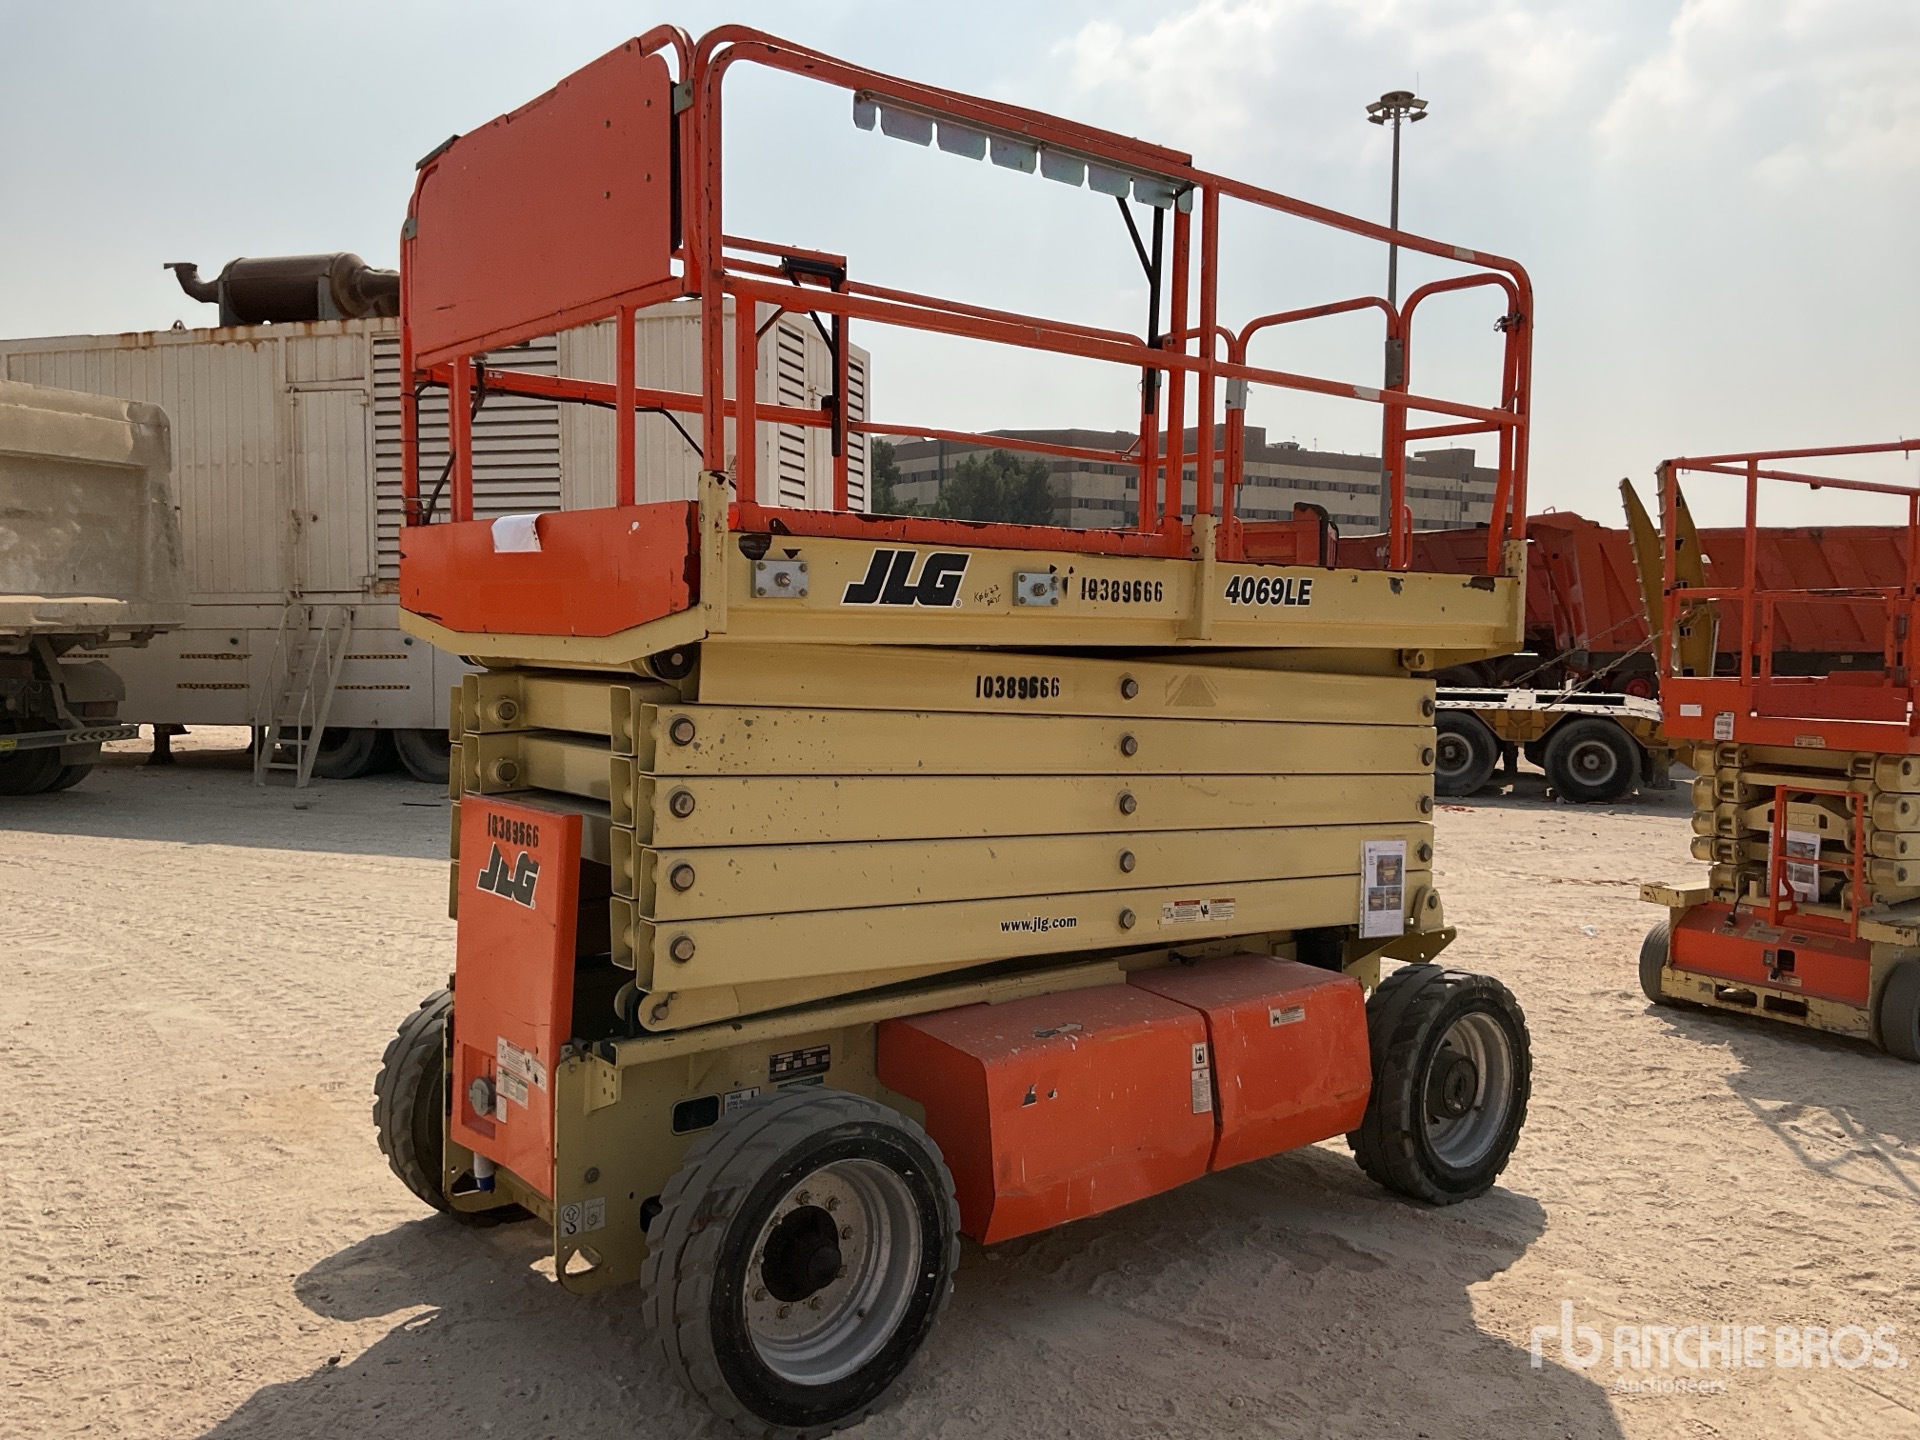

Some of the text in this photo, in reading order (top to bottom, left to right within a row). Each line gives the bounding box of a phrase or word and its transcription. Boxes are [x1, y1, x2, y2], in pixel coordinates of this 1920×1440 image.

[842, 549, 971, 606] JLG
[1081, 577, 1163, 604] 10389666
[1225, 575, 1313, 606] 4069LE
[976, 675, 1061, 699] 10389666
[1000, 915, 1077, 932] www.jlg.com
